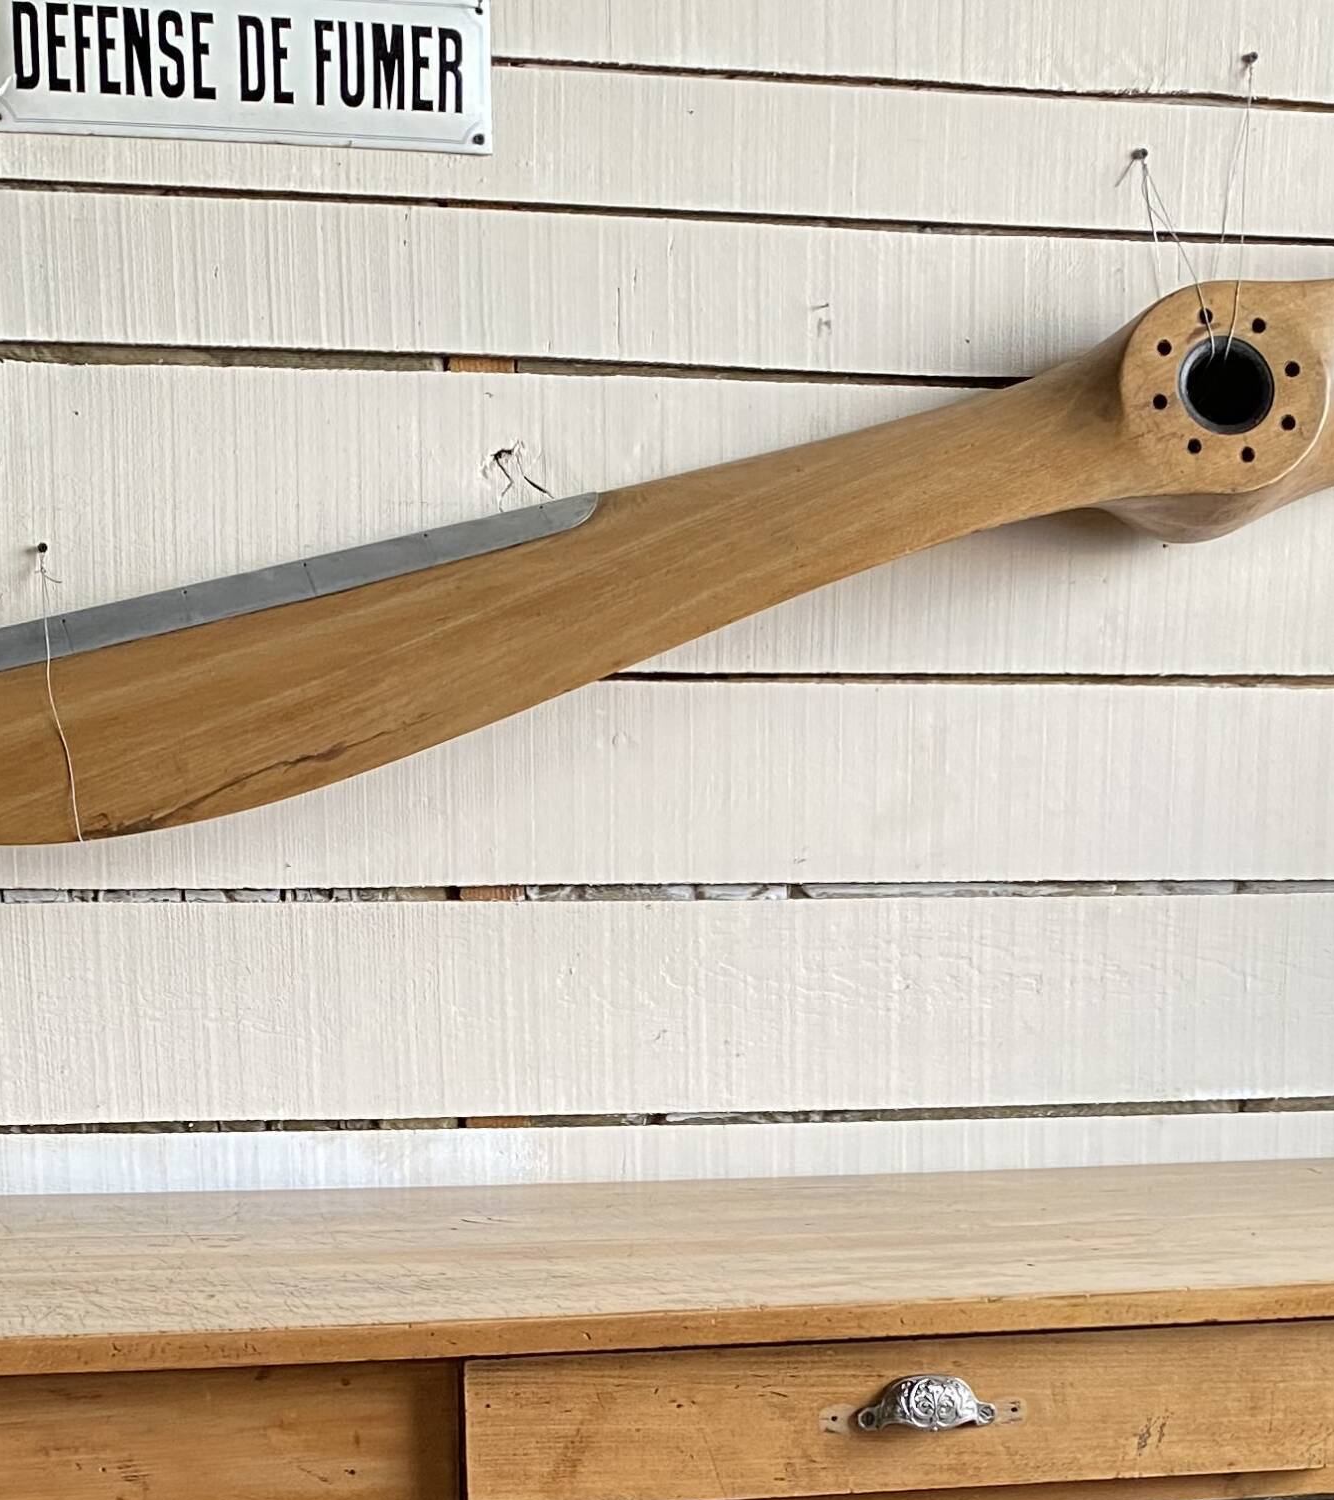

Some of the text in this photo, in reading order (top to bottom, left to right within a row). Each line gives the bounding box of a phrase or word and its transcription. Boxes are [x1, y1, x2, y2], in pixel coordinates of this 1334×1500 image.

[12, 1, 463, 114] DEFENSE DE FUMER
